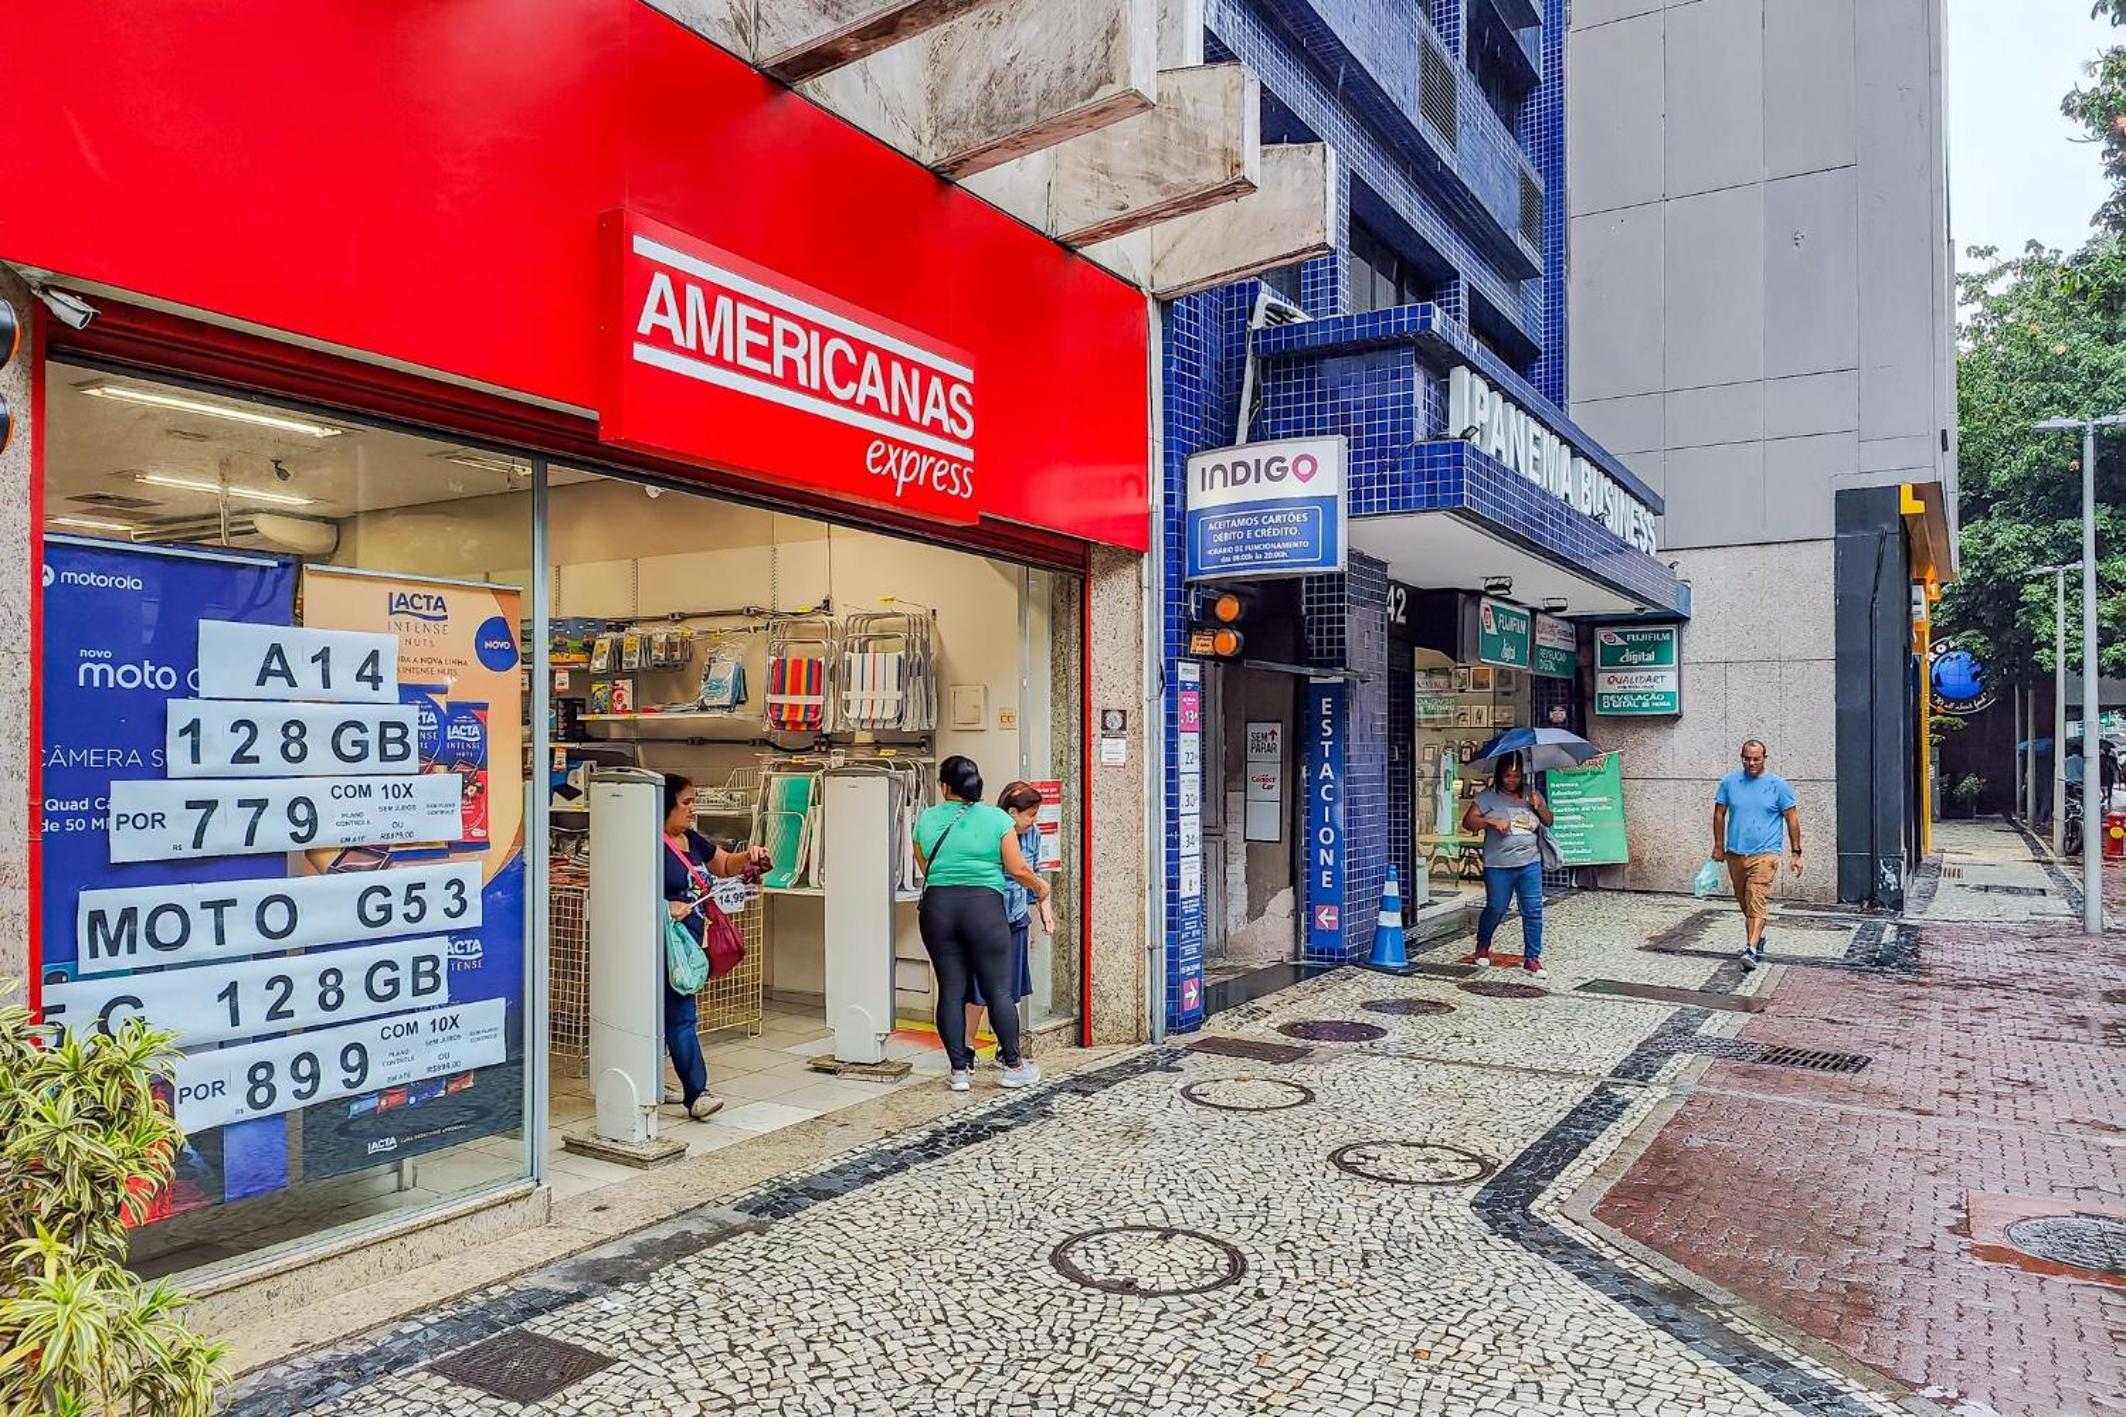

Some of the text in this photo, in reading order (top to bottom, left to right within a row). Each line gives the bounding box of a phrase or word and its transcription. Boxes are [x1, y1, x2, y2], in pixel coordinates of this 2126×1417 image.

[637, 271, 974, 440] AMERICANAS
[866, 440, 974, 498] express
[1450, 365, 1657, 558] IPANEMA BUSINESS
[1201, 453, 1318, 492] INDIGO
[1208, 511, 1309, 531] ACEITAMOS CARTÕES
[1246, 529, 1253, 539] E
[60, 570, 144, 591] motorola
[388, 592, 448, 621] LACTA
[1386, 584, 1407, 624] 42
[387, 621, 449, 635] INTENSE
[1626, 632, 1671, 642] FUJIFILM
[404, 638, 435, 648] NUTS
[483, 641, 511, 650] NOVO
[79, 649, 113, 659] novo
[420, 657, 444, 665] NOVA
[445, 658, 469, 667] LINHA
[1619, 648, 1655, 664] digital
[78, 660, 178, 690] moto
[1607, 674, 1666, 686] QUALIDART
[1602, 693, 1665, 702] REVELAÇÃO
[447, 724, 481, 741] LACTA
[1250, 731, 1268, 741] SEM
[1250, 743, 1278, 753] PARAR
[331, 784, 372, 800] COM
[380, 783, 414, 800] 10X
[1319, 698, 1335, 888] ESTACIONE
[45, 798, 89, 812] Quad
[68, 818, 91, 831] 50
[97, 817, 110, 830] M
[115, 812, 168, 831] POR
[184, 795, 319, 849] 779
[87, 878, 469, 959] MOTO G53
[447, 937, 484, 960] ACTA
[451, 959, 483, 972] TENSE
[380, 1021, 419, 1041] COM
[429, 1014, 462, 1034] 10X
[246, 1042, 370, 1111] 899
[178, 1079, 226, 1105] POR
[367, 1135, 398, 1155] LACTA
